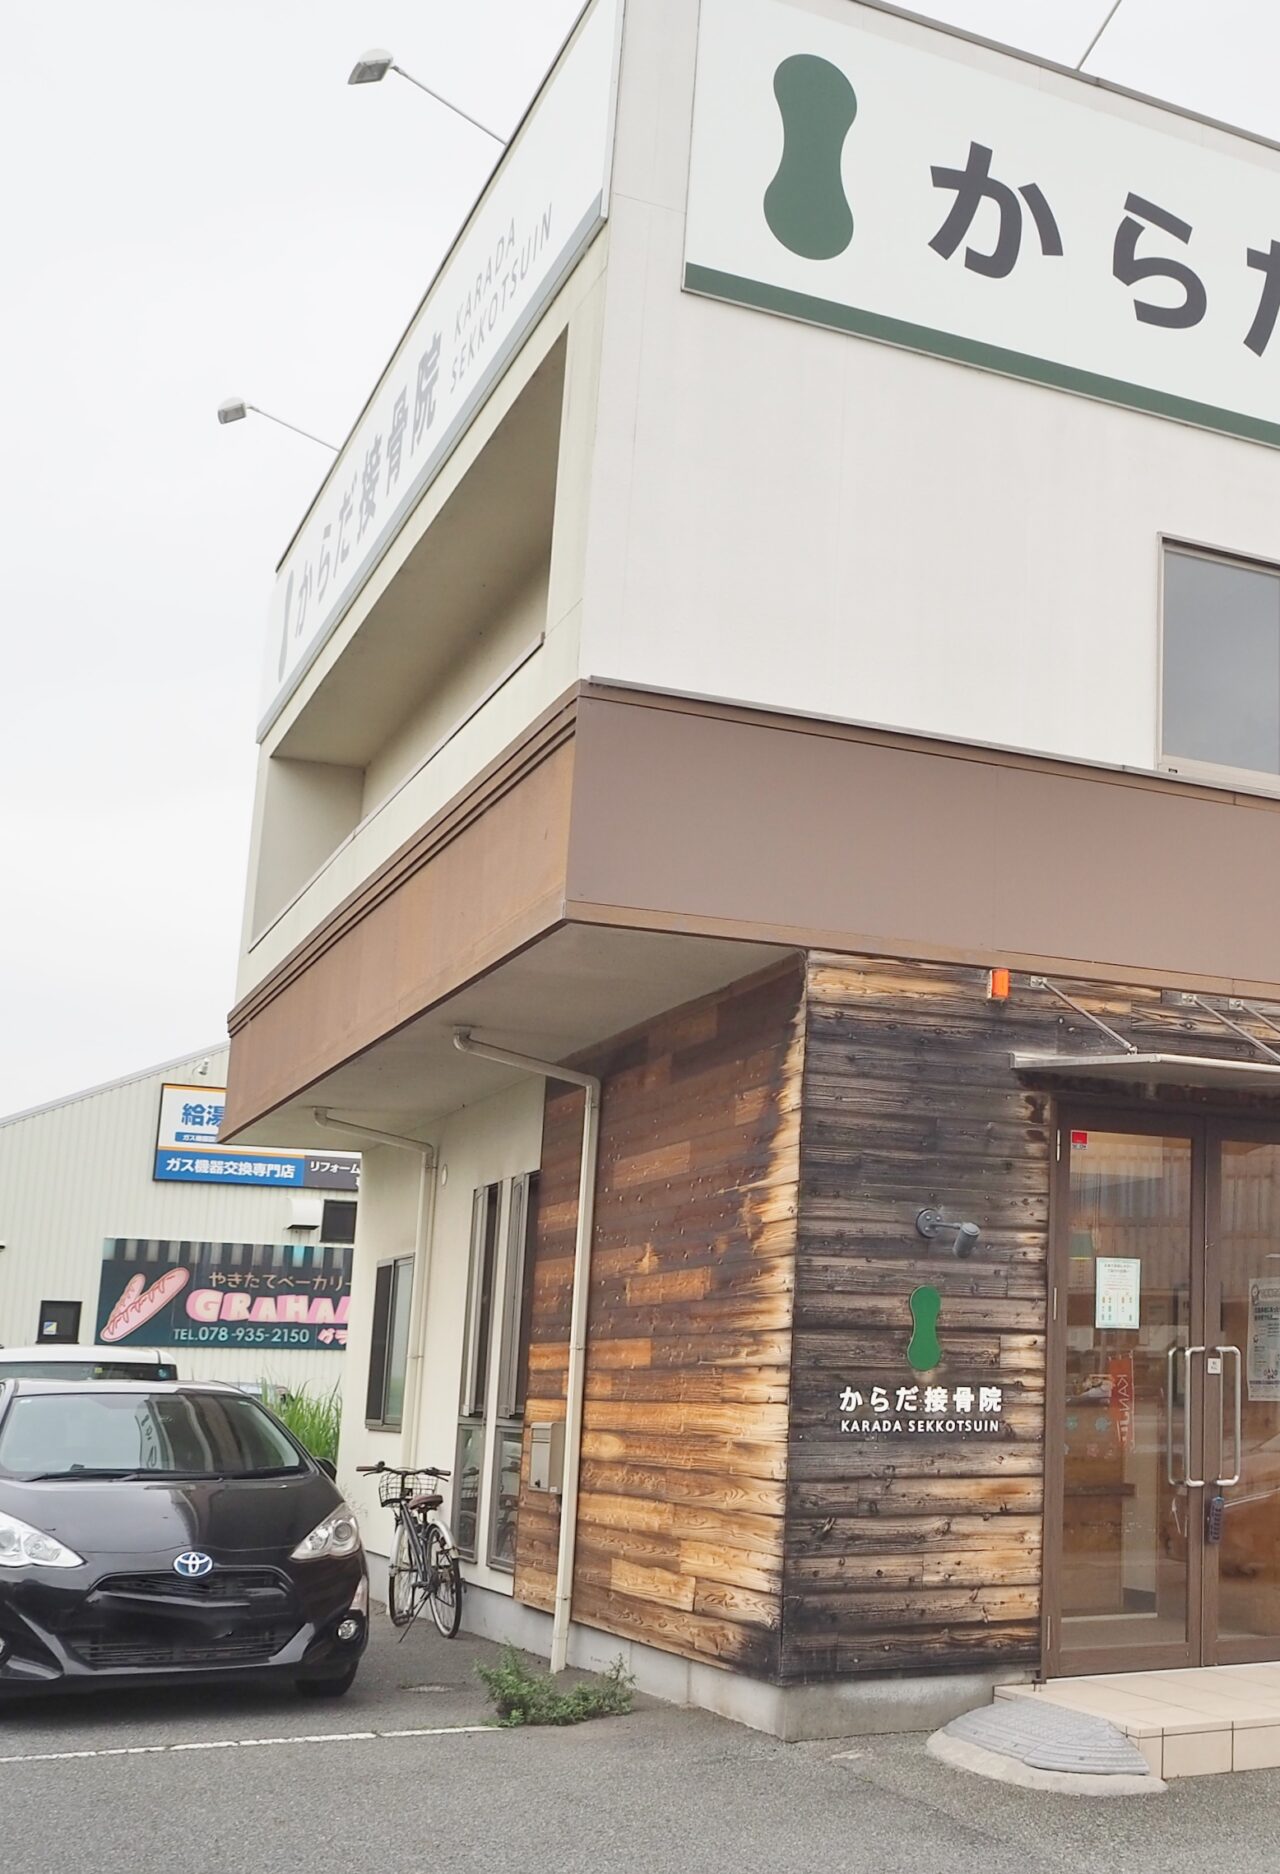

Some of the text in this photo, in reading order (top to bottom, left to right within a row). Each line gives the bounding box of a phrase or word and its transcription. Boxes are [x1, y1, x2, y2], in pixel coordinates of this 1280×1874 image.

[454, 217, 516, 343] KARADA
[450, 201, 552, 394] SEKKOTSUIN
[165, 1157, 296, 1179] ガス機器交換専門店
[208, 1271, 352, 1292] やきたてベーカリ
[839, 1385, 1002, 1413] からだ接骨院
[841, 1420, 999, 1432] KARADA SEKKOTSUIN
